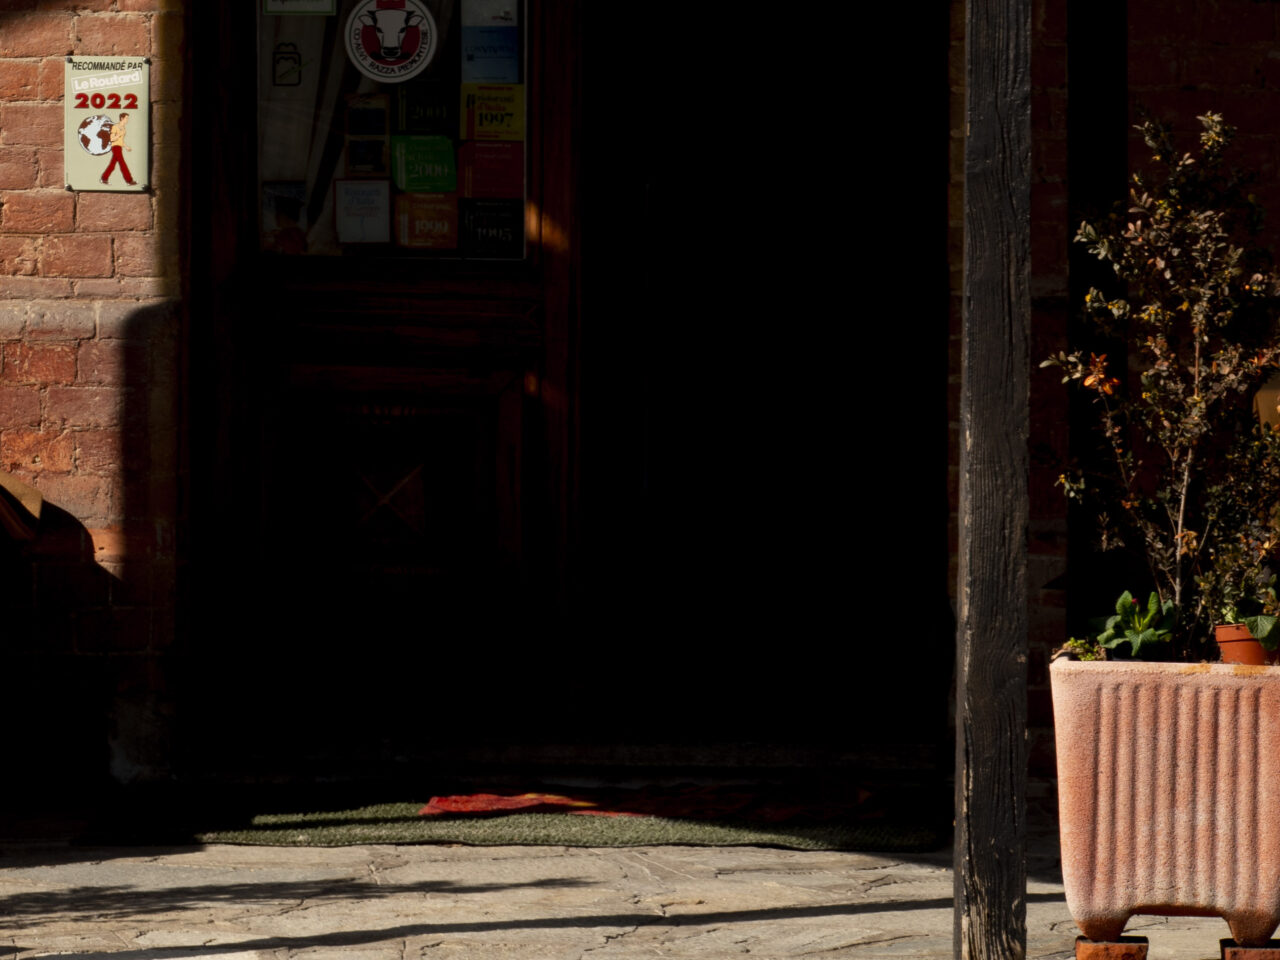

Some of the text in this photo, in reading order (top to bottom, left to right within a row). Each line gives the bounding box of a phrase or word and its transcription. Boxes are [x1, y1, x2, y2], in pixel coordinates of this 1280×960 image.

[368, 61, 397, 74] RAZZA
[398, 28, 429, 73] PIEMONTESE
[72, 60, 143, 71] RECOMMANDÉ PAR
[74, 72, 140, 91] Le Routard
[74, 92, 139, 110] 2022
[478, 111, 514, 128] 1997
